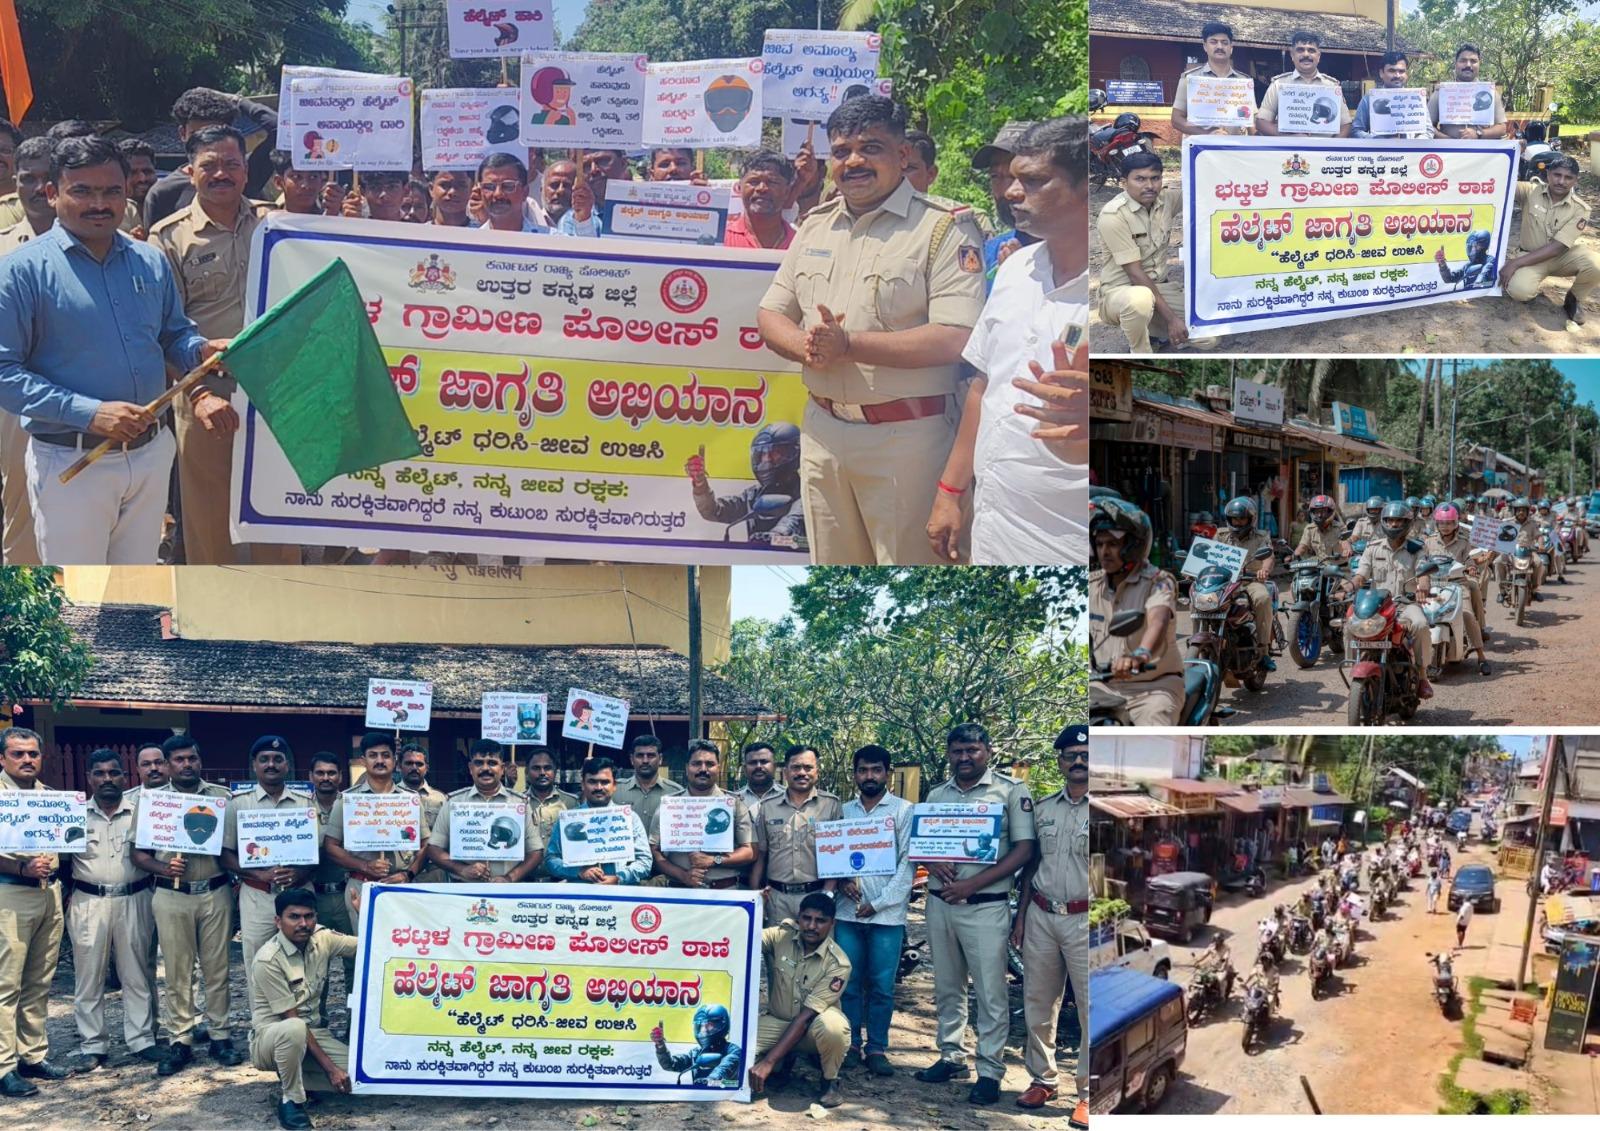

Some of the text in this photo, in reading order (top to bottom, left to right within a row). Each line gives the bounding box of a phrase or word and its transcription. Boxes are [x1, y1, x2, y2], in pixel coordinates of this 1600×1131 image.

[764, 43, 857, 62] ಜೀವ ಅಮೂಲ್ಯ
[438, 138, 449, 147] ISI
[1321, 165, 1408, 178] ಉತ್ತರ ಕನ್ನಡ ಜಿಲ್ಲೆ
[1215, 178, 1496, 207] ಭಟ್ಕಳ ಗ್ರಾಮೀಣ ಪೊಲೀಸ್ ಠಾಣೆ
[1220, 207, 1474, 250] ಹೆಲ್ಮೆಟ್ ಜಾಗೃತಿ ಅಭಿಯಾನ
[1392, 246, 1425, 257] ಉಳಿಸಿ
[486, 260, 631, 280] ಕರ್ನಾಟಕ ರಾಜ್ಯ ಪೊಲೀಸ್
[1255, 278, 1279, 293] ನನ್ನ
[1327, 272, 1348, 287] ನನ್ನ
[1352, 270, 1376, 282] ಜೀವ
[477, 278, 637, 307] ಉತ್ತರ ಕನ್ನಡ ಜಿಲ್ಲೆ
[1217, 300, 1242, 312] ನಾನು
[1249, 291, 1314, 312] ಸುರಕ್ಷಿತವಾಗಿದ್ದರೆ
[1317, 290, 1335, 303] ನನ್ನ
[1337, 288, 1369, 300] ಕುಟುಂಬ
[403, 302, 542, 339] ಗ್ರಾಮೀಣ
[562, 308, 719, 347] ಪೊಲೀಸ್
[440, 359, 566, 428] ಜಾಗೃತಿ
[587, 371, 768, 428] ಅಭಿಯಾನ
[600, 441, 665, 459] ಉಳಿಸಿ
[473, 472, 511, 498] ನನ್ನ
[521, 477, 564, 493] ಜೀವ
[574, 479, 629, 503] ರಕ್ಷಕ:
[284, 491, 687, 532] ನಾನು ಸುರಕ್ಷಿತವಾಗಿದ್ದರೆ ನನ್ನ ಕುಟುಂಬ ಸುರಕ್ಷಿತವಾಗಿರುತ್ತದೆ
[511, 913, 617, 931] ಉತ್ತರ ಕನ್ನಡ ಜಿಲ್ಲೆ
[391, 925, 730, 958] ಭಟ್ಕಳ ಗ್ರಾಮೀಣ ಪೊಲೀಸ್ ಠಾಣೆ
[393, 961, 702, 1011] ಹೆಲ್ಮೆಟ್ ಜಾಗೃತಿ ಅಭಿಯಾನ
[594, 1018, 637, 1031] ಉಳಿಸಿ
[427, 1040, 454, 1057] ನನ್ನ
[511, 1042, 537, 1060] ನನ್ನ
[543, 1044, 572, 1056] ಜೀವ
[578, 1044, 614, 1061] ರಕ್ಷಕ:
[385, 1059, 652, 1080] ನಾನು ಸುರಕ್ಷಿತವಾಗಿದ್ದರೆ ನನ್ನ ಕುಟುಂಬ ಸುರಕ್ಷಿತವಾಗಿರುತ್ತದೆ
